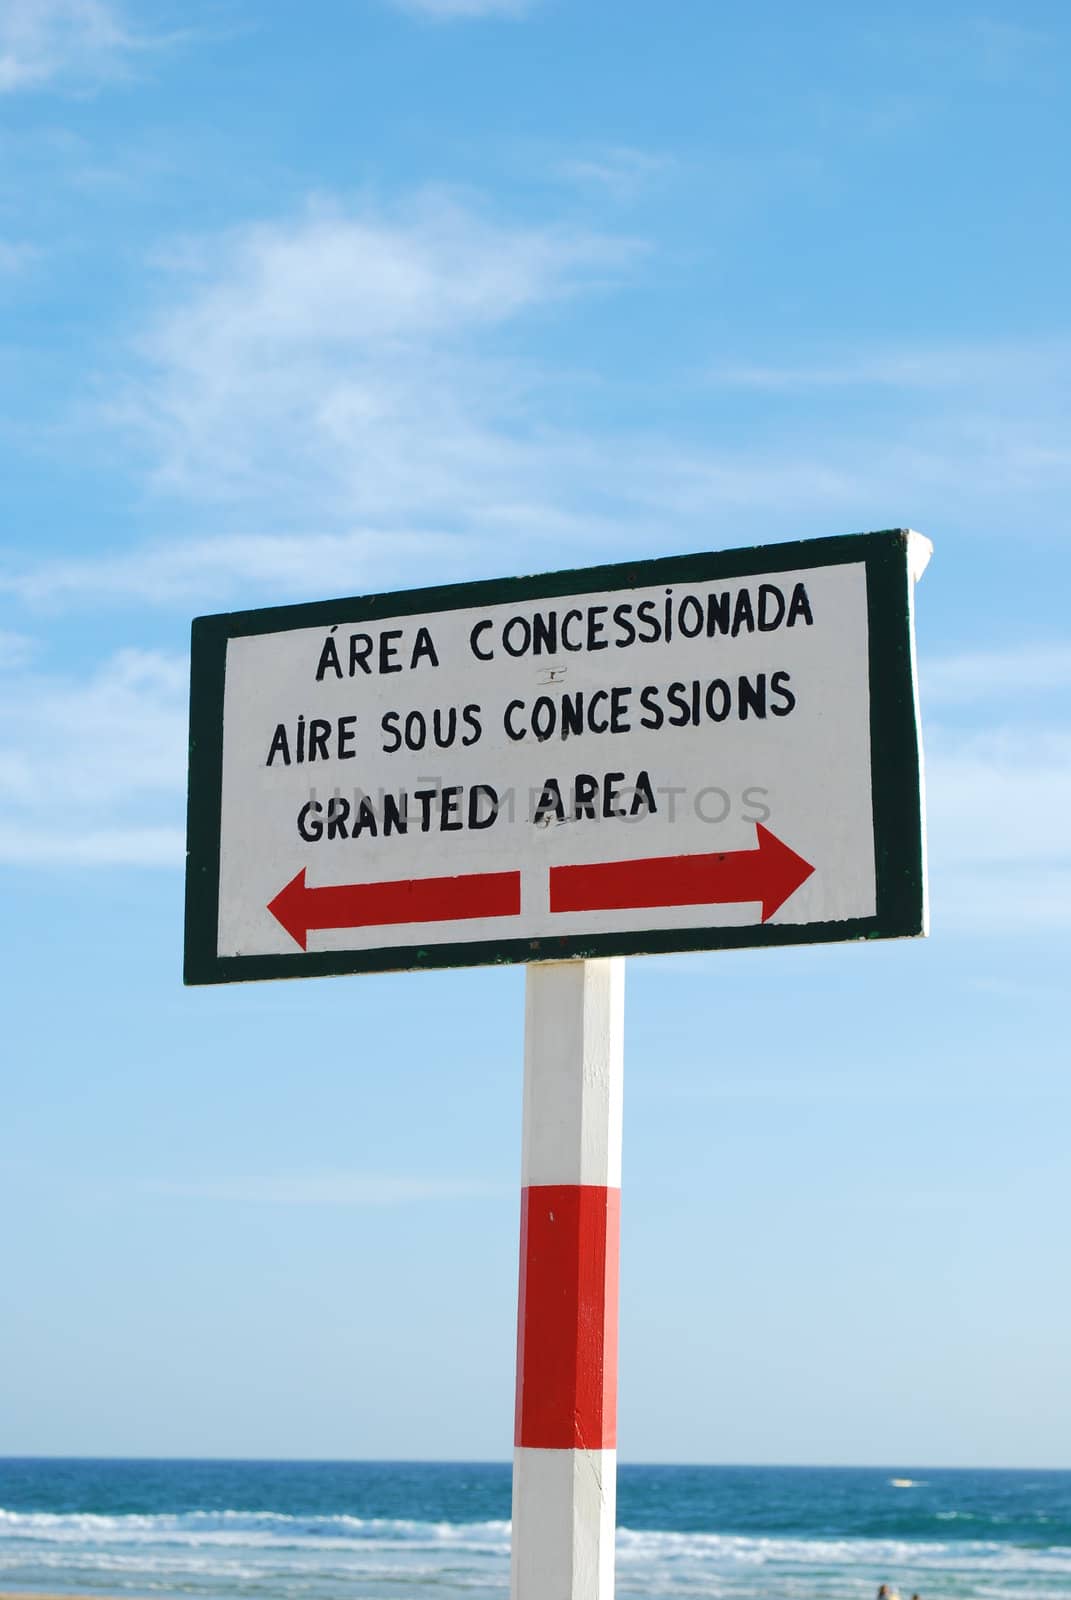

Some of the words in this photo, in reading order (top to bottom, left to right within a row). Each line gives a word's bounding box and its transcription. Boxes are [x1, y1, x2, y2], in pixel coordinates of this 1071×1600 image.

[315, 625, 440, 682] ÁREA
[381, 703, 482, 754] SOUS
[503, 670, 796, 743] CONCESSIONS
[297, 784, 499, 843] GRANTED
[534, 770, 658, 823] AREA
